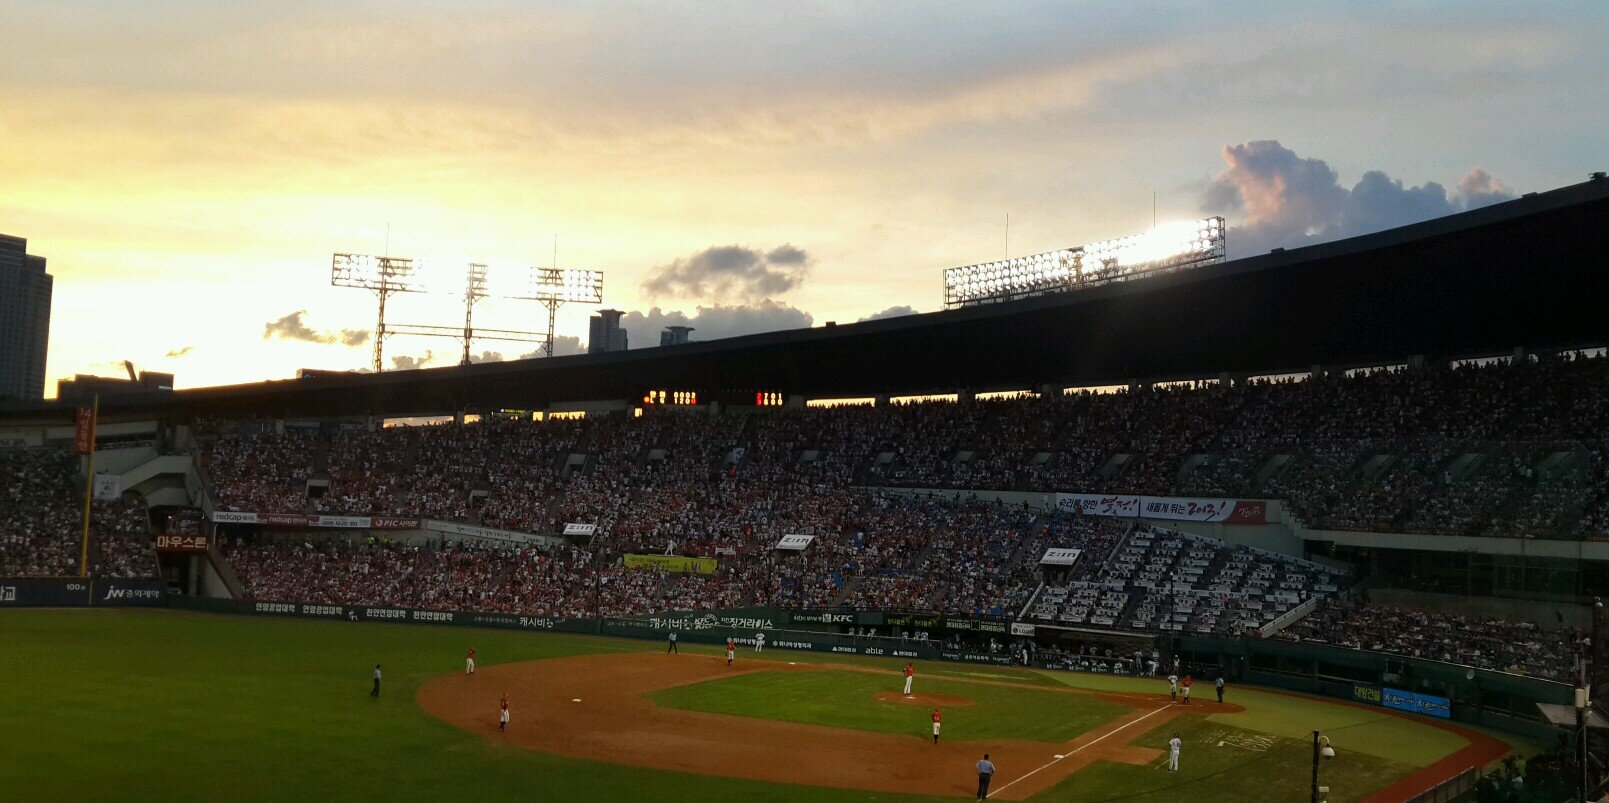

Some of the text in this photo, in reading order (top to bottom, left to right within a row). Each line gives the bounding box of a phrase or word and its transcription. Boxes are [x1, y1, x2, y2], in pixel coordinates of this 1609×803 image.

[1146, 502, 1168, 512] 새롭게
[1170, 505, 1186, 514] 뛰는
[216, 513, 242, 521] redcap
[270, 516, 292, 524] redcap
[519, 616, 545, 628] 캐시비
[649, 617, 683, 630] 캐시비
[730, 617, 774, 630] 징거라이스
[832, 614, 854, 623] KFC
[865, 646, 884, 655] able
